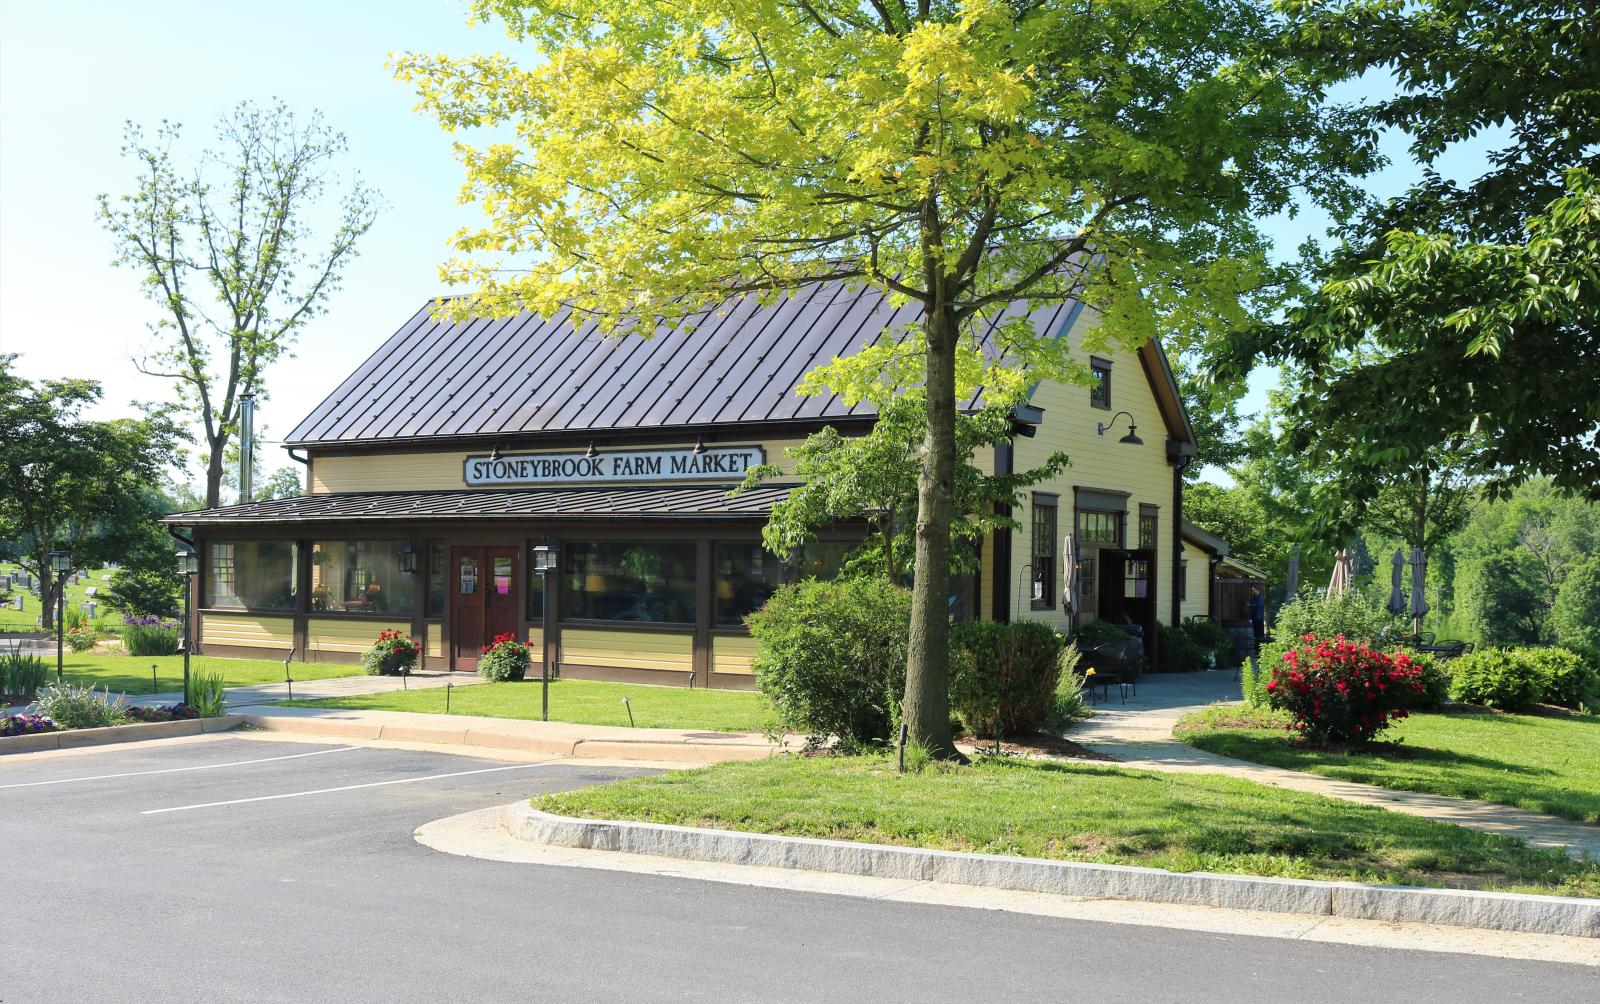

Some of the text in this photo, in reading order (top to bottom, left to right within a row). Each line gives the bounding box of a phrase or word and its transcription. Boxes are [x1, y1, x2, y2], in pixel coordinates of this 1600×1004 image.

[473, 453, 753, 479] STONEYBROOK FARM MARKET
